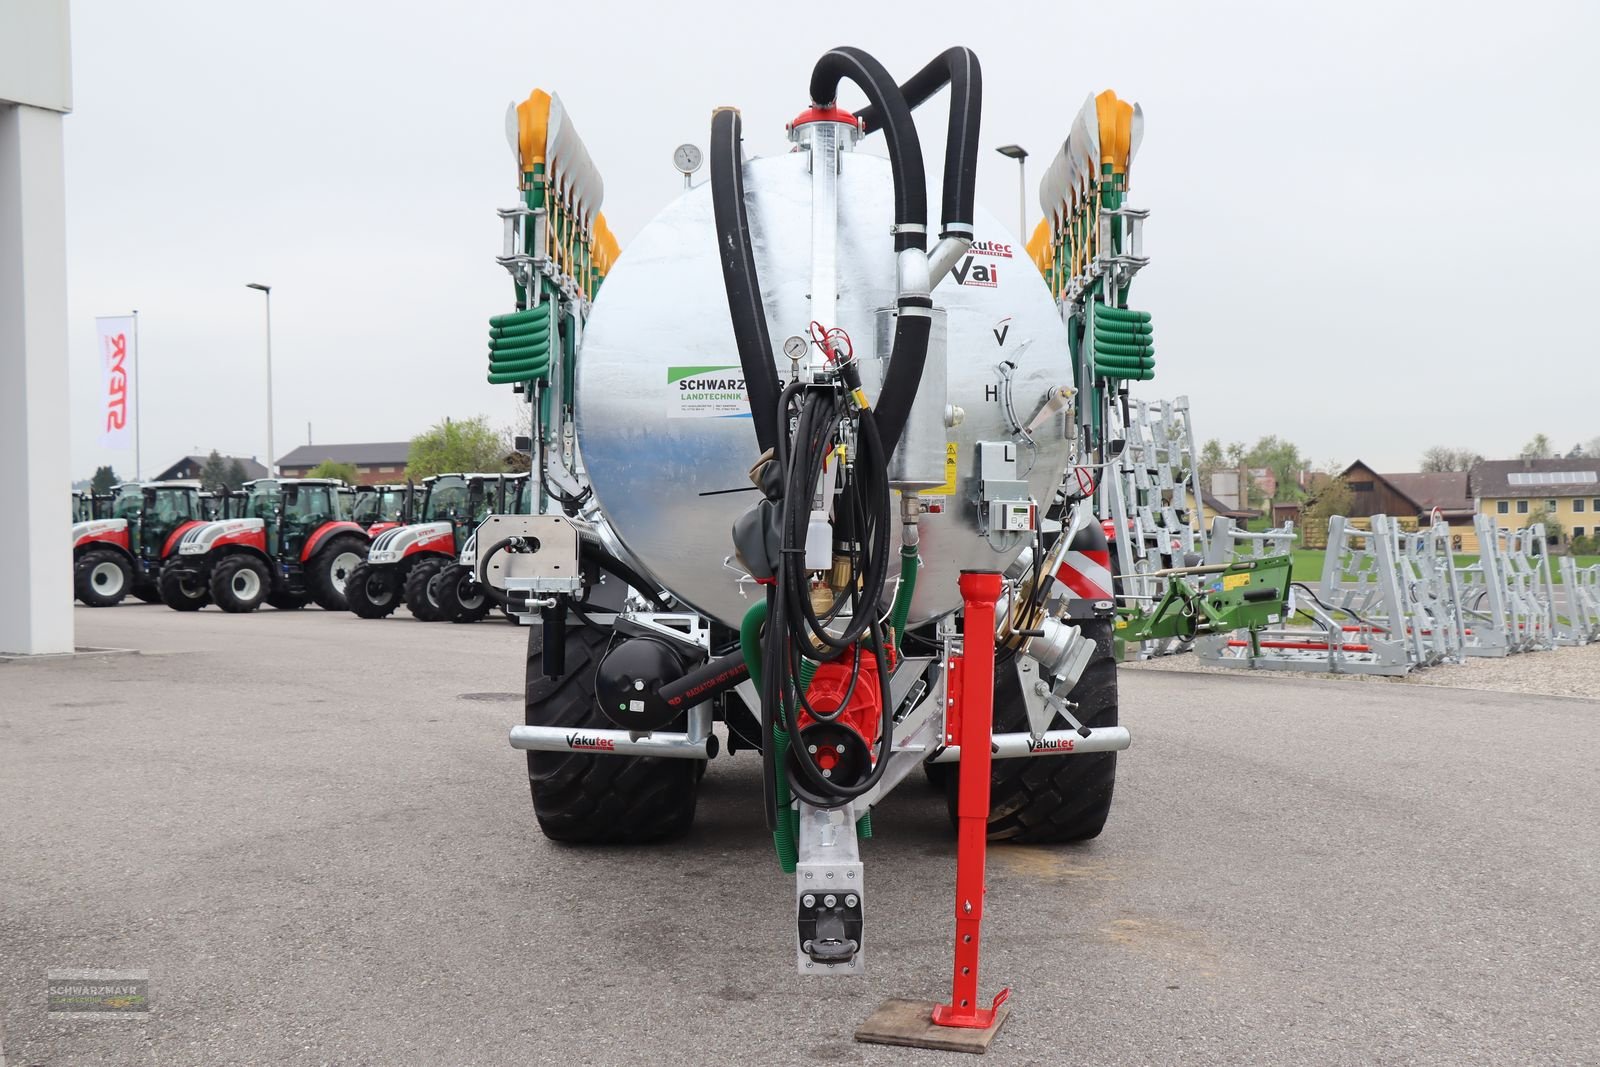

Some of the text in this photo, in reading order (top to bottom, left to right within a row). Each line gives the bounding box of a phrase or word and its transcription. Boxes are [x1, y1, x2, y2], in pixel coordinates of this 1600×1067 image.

[970, 241, 1012, 253] kutec
[951, 256, 997, 285] Vai
[680, 379, 785, 391] SCHWARZR
[985, 384, 998, 402] H
[681, 393, 742, 401] LANDTECHNIK
[1004, 445, 1015, 462] L
[685, 679, 717, 698] RADIATOR
[566, 732, 614, 748] Vakutec
[1027, 738, 1074, 752] Vakutec
